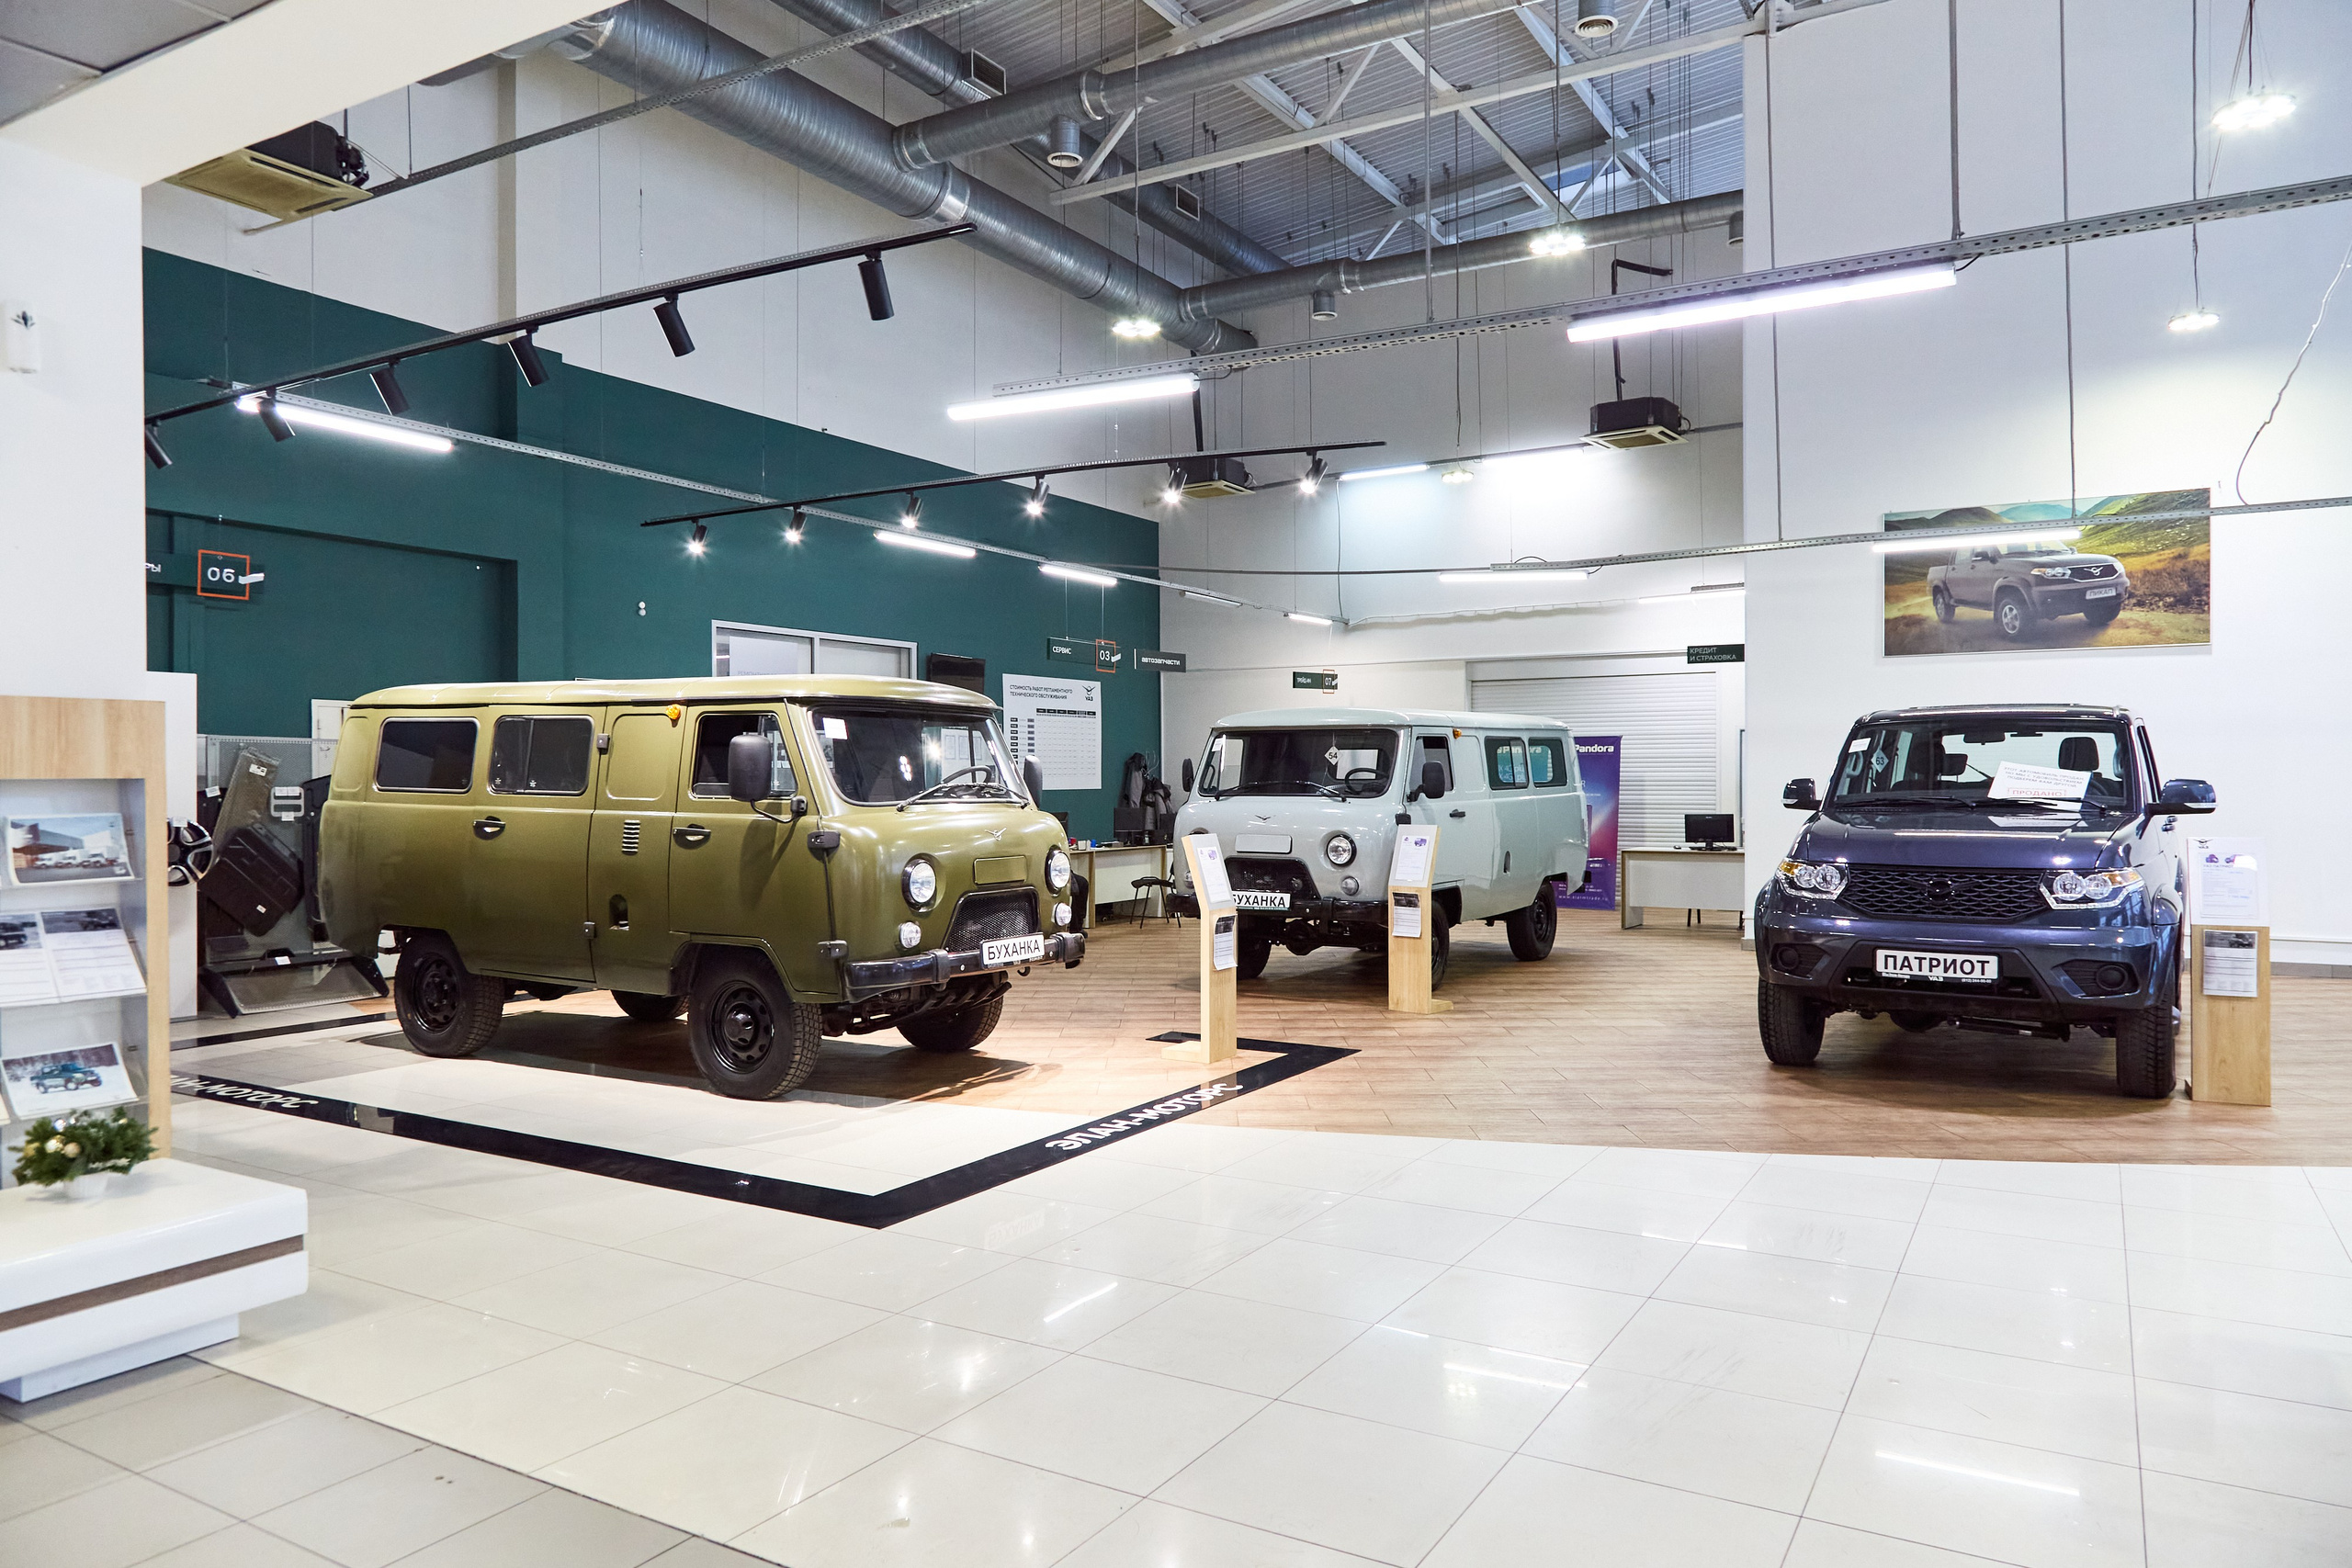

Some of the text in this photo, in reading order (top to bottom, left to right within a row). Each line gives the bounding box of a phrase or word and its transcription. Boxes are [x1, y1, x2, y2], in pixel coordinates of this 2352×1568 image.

[207, 567, 235, 582] 06
[1052, 646, 1111, 660] СЕРВИС 03
[1325, 677, 1332, 686] 07
[1875, 756, 1885, 766] 63
[2012, 789, 2063, 797] ПРОДАНО
[988, 939, 1040, 961] БУХАНКА
[1883, 953, 1990, 976] ПАТРИОТ
[1045, 1083, 1244, 1151] ЭЛАН-МОТОРС
